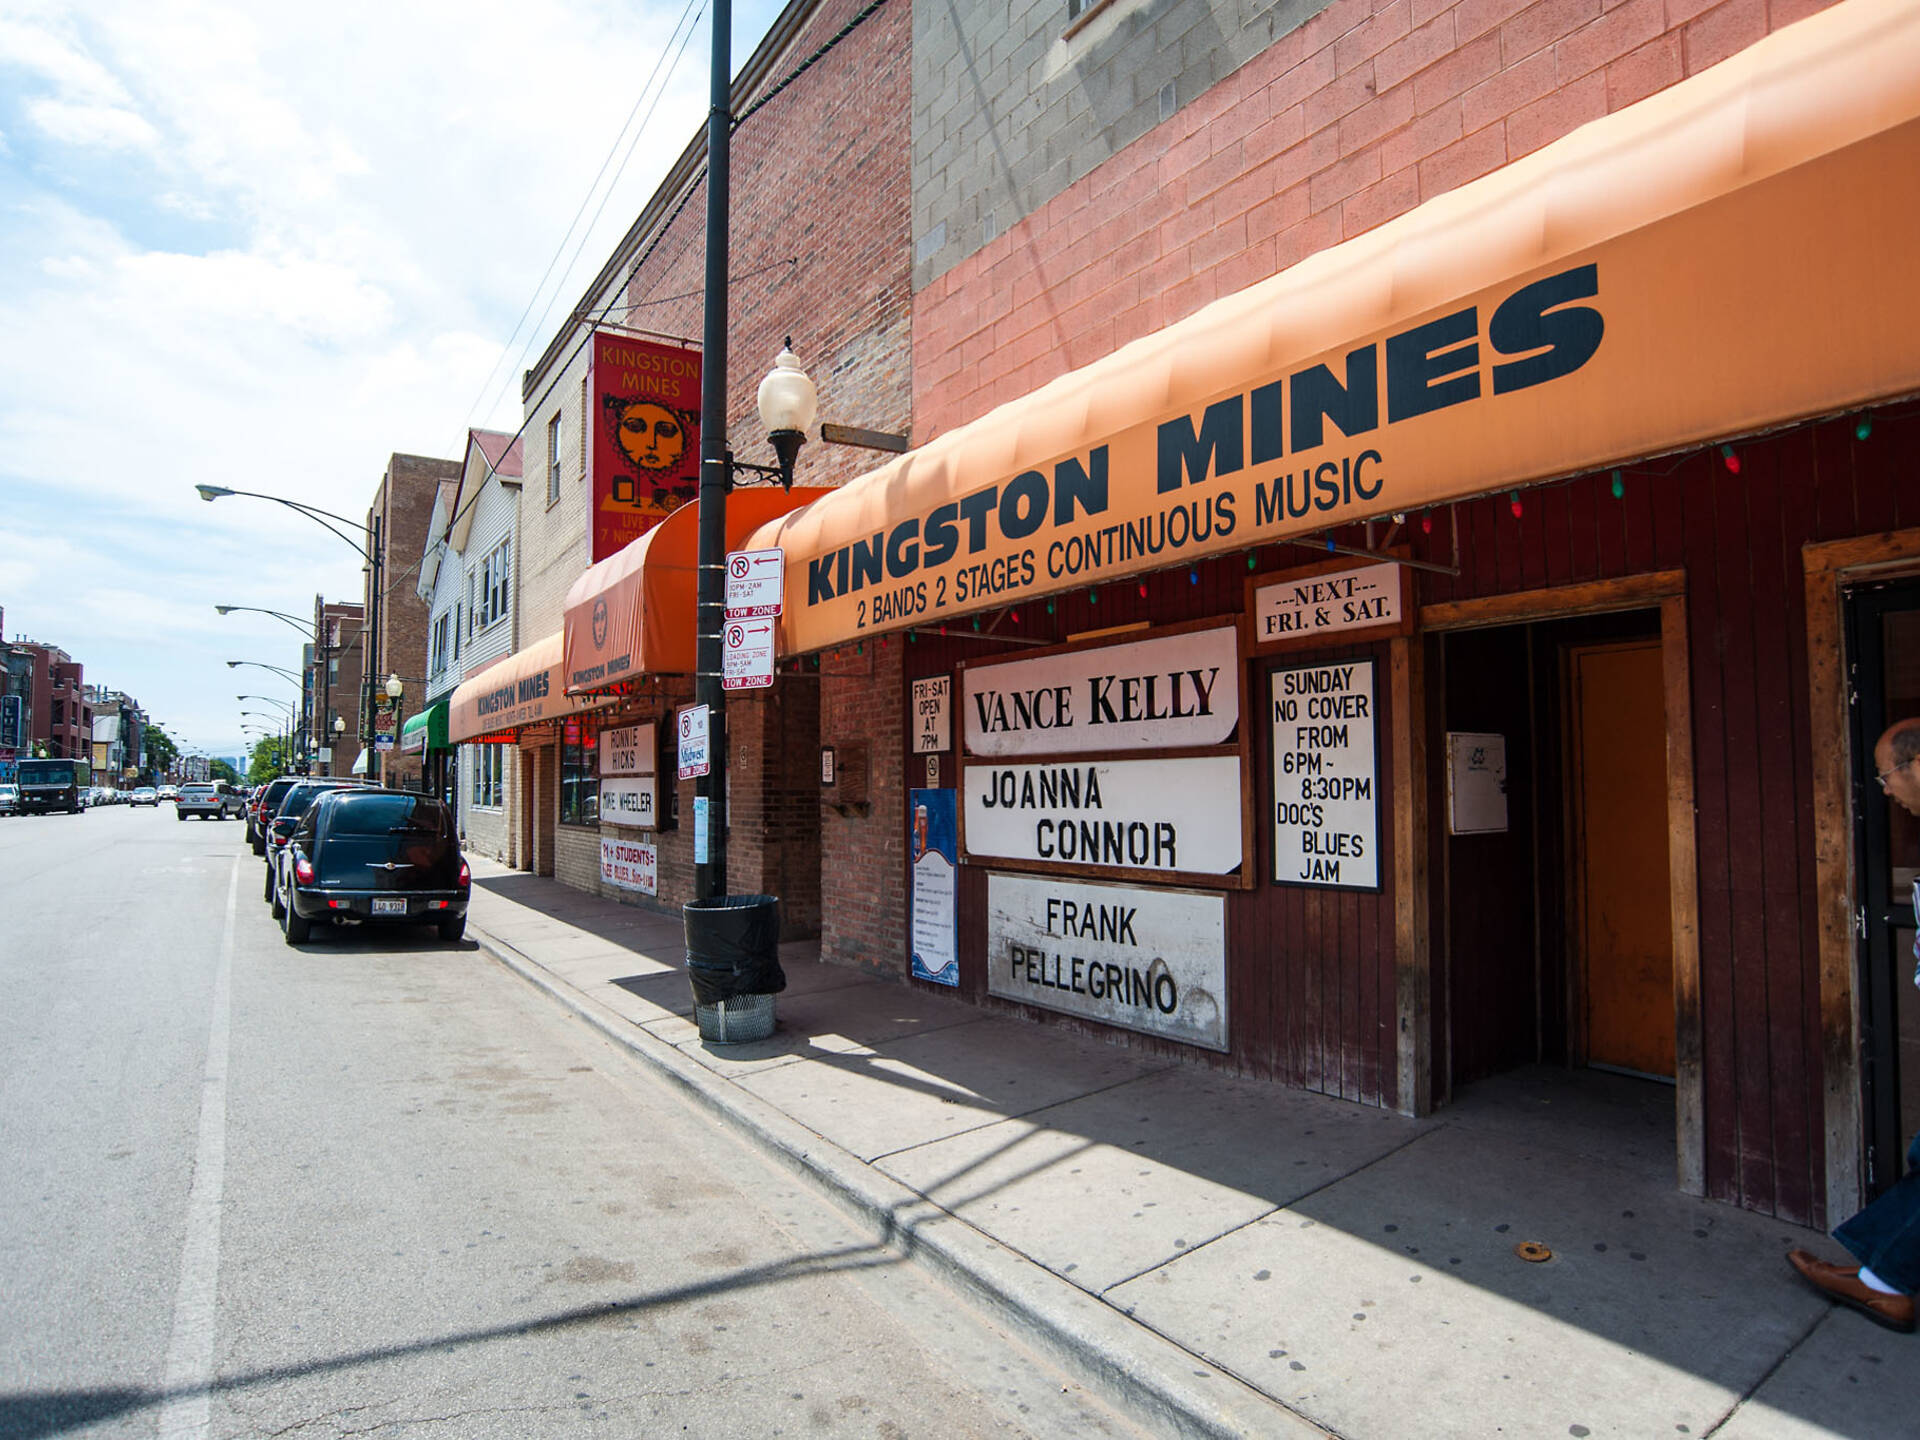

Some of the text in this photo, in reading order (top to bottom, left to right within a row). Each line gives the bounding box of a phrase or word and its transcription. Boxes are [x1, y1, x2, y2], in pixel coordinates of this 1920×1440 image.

[602, 345, 699, 379] KINGSTON
[621, 371, 681, 397] MINES
[808, 262, 1605, 607] KINGSTON MINES
[856, 449, 1386, 628] 2 BANDS 2 STAGES CONTINUOUS MUSIC
[728, 604, 777, 617] TOW ZONE
[1265, 597, 1391, 635] FRI. & SAT.
[573, 654, 631, 684] KINGSTON MINES
[726, 675, 768, 688] TOW ZONE
[1284, 667, 1353, 695] SUNDAY
[477, 670, 550, 717] KINGSTON MINES
[914, 679, 948, 700] FRI-SAT
[972, 667, 1220, 734] VANCE KELLY
[919, 699, 940, 716] OPEN
[1275, 694, 1369, 723] NO COVER
[925, 716, 936, 733] AT
[1296, 724, 1348, 750] FROM
[611, 728, 639, 749] RONNIE
[920, 734, 938, 750] 7PM
[612, 750, 636, 770] HICKS
[982, 767, 1104, 809] JOANNA
[1302, 777, 1371, 800] 8:30PM
[619, 792, 652, 813] WHEELER
[1277, 802, 1323, 827] DOC'S
[1036, 819, 1177, 868] CONNOR
[1302, 830, 1364, 858] BLUES
[1299, 858, 1340, 883] JAM
[1046, 898, 1139, 947] FRANK
[1012, 944, 1178, 1015] PELLEGRINO
